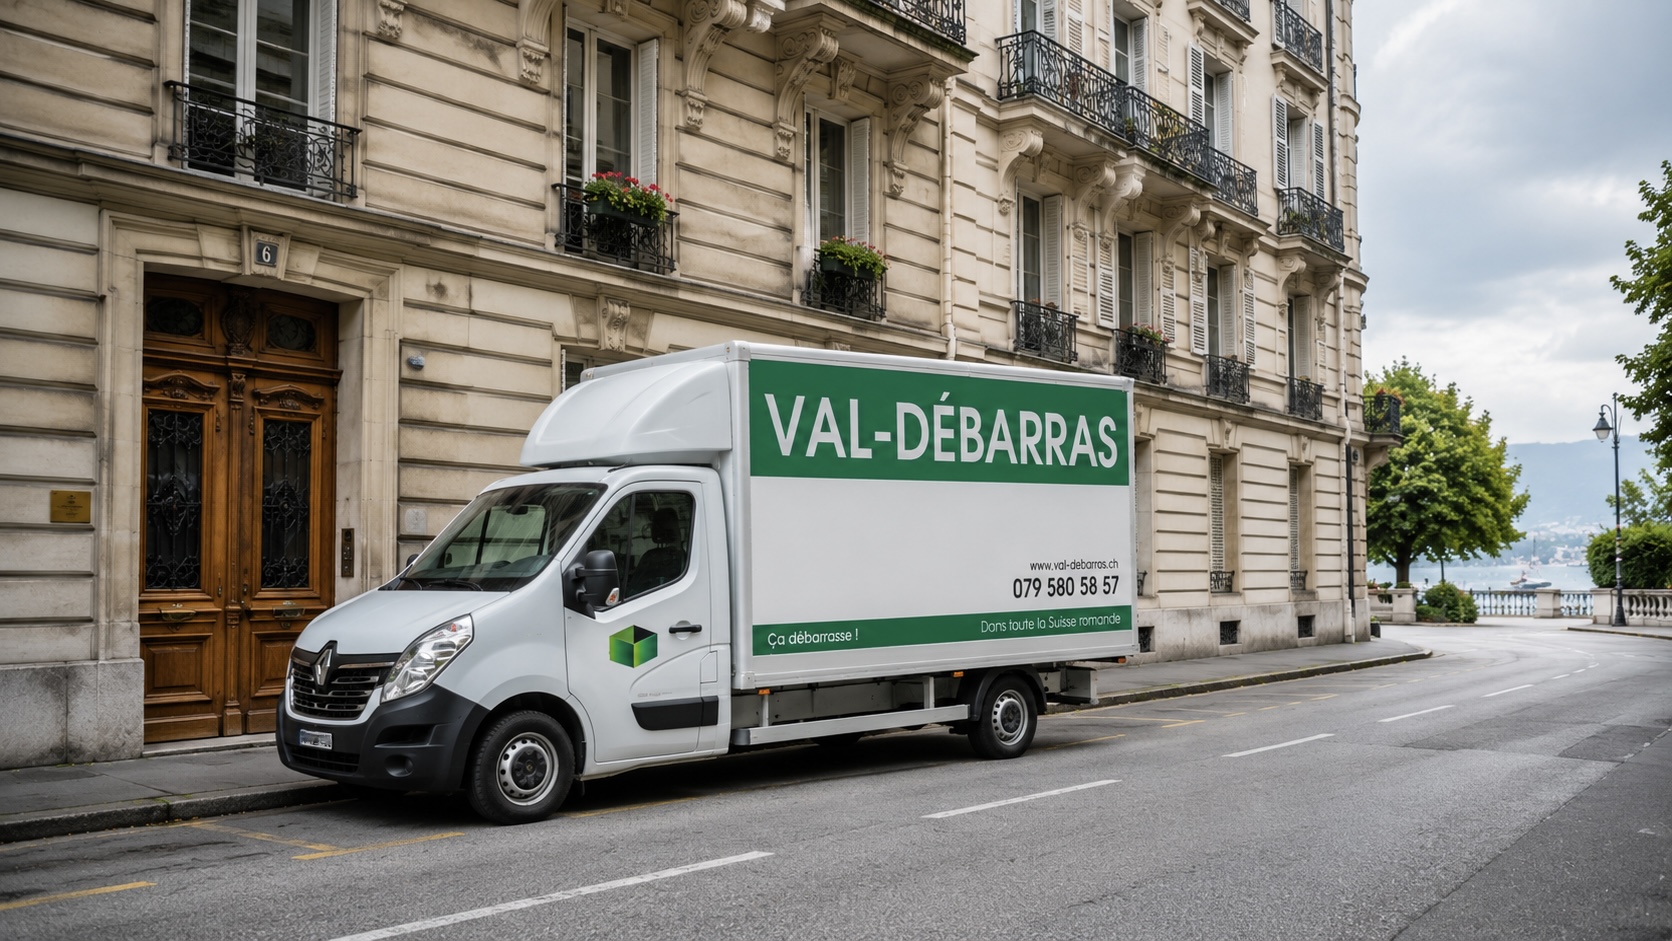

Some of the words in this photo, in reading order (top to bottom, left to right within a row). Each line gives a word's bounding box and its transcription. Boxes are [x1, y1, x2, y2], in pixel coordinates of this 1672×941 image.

[262, 245, 271, 263] 6
[764, 391, 1118, 468] VAL-DÉBARRAS
[1013, 578, 1042, 598] 079
[1047, 577, 1075, 597] 580
[1080, 576, 1097, 595] 58
[1102, 575, 1119, 595] 57
[1009, 618, 1035, 631] toute
[1037, 617, 1046, 629] la
[1048, 616, 1077, 629] Suisse
[1079, 613, 1121, 627] romande
[767, 632, 785, 649] Ça
[788, 630, 852, 645] débarrasse
